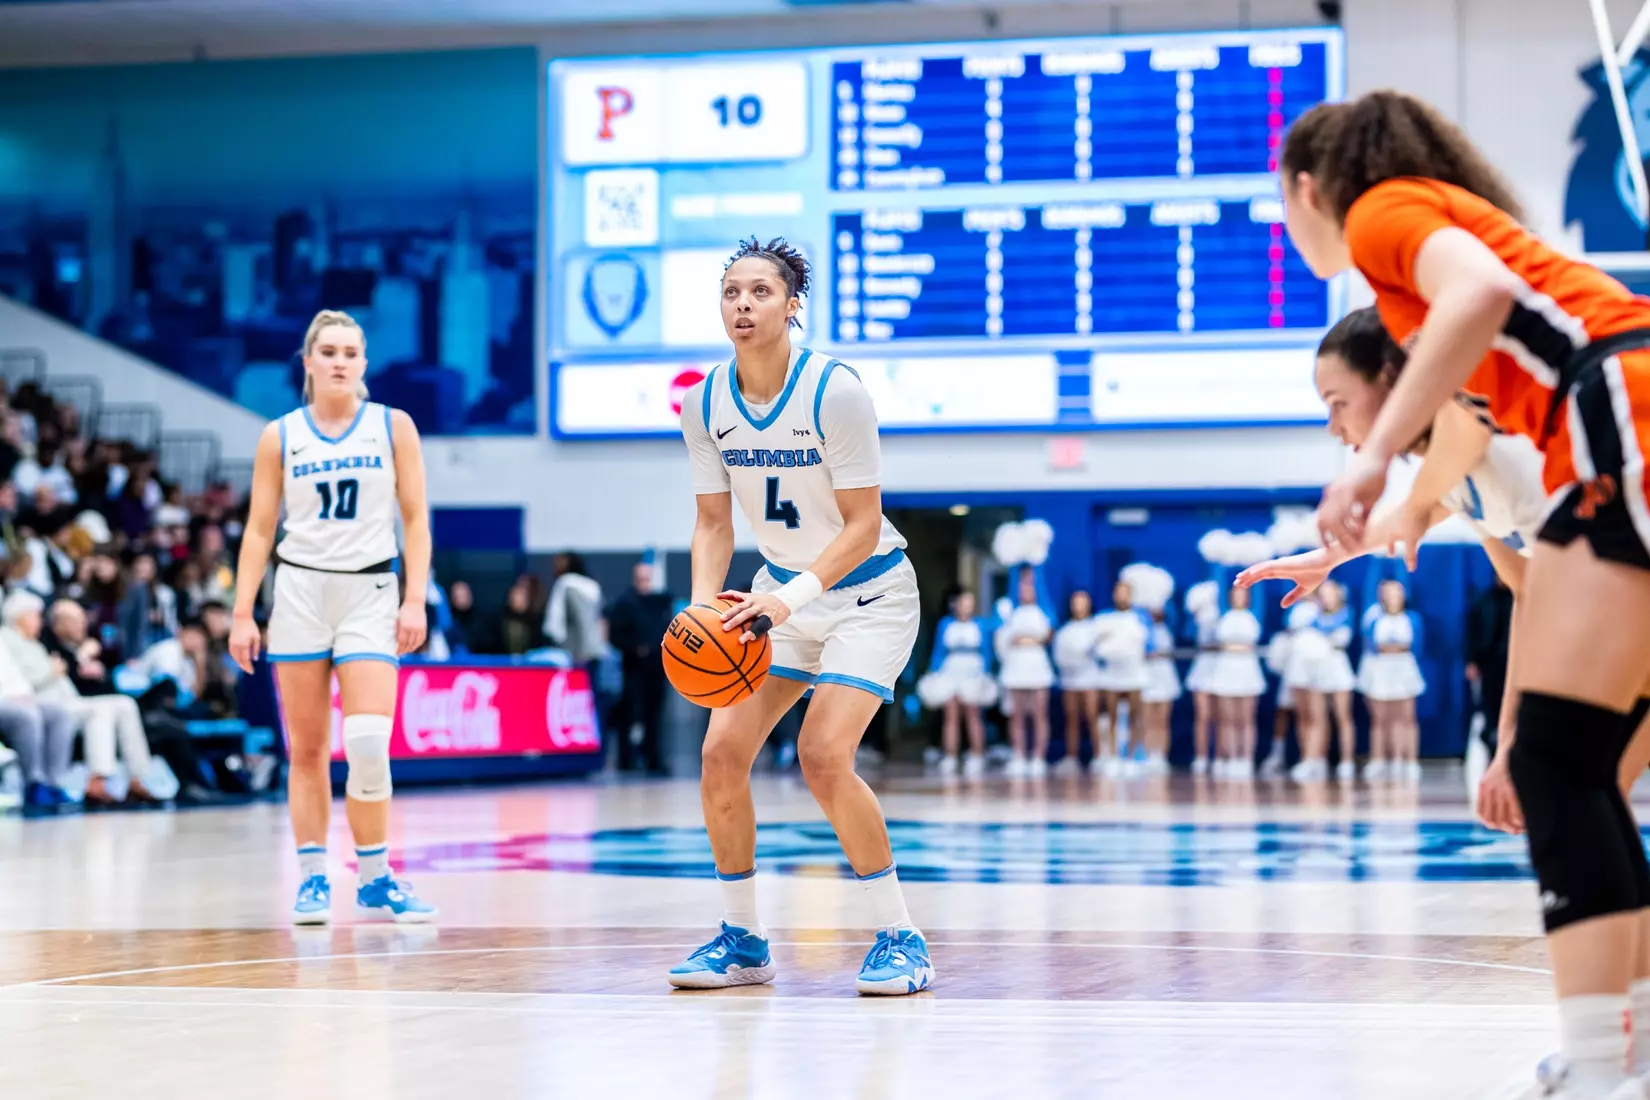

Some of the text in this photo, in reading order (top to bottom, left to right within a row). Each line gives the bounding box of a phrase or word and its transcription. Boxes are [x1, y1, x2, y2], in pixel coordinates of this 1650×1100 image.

[597, 85, 634, 141] P
[711, 94, 763, 127] 10
[292, 455, 383, 479] COLUMBIA
[721, 448, 822, 468] COLUMBIA
[315, 478, 360, 520] 10
[765, 476, 801, 529] 4
[668, 618, 705, 655] ELITE
